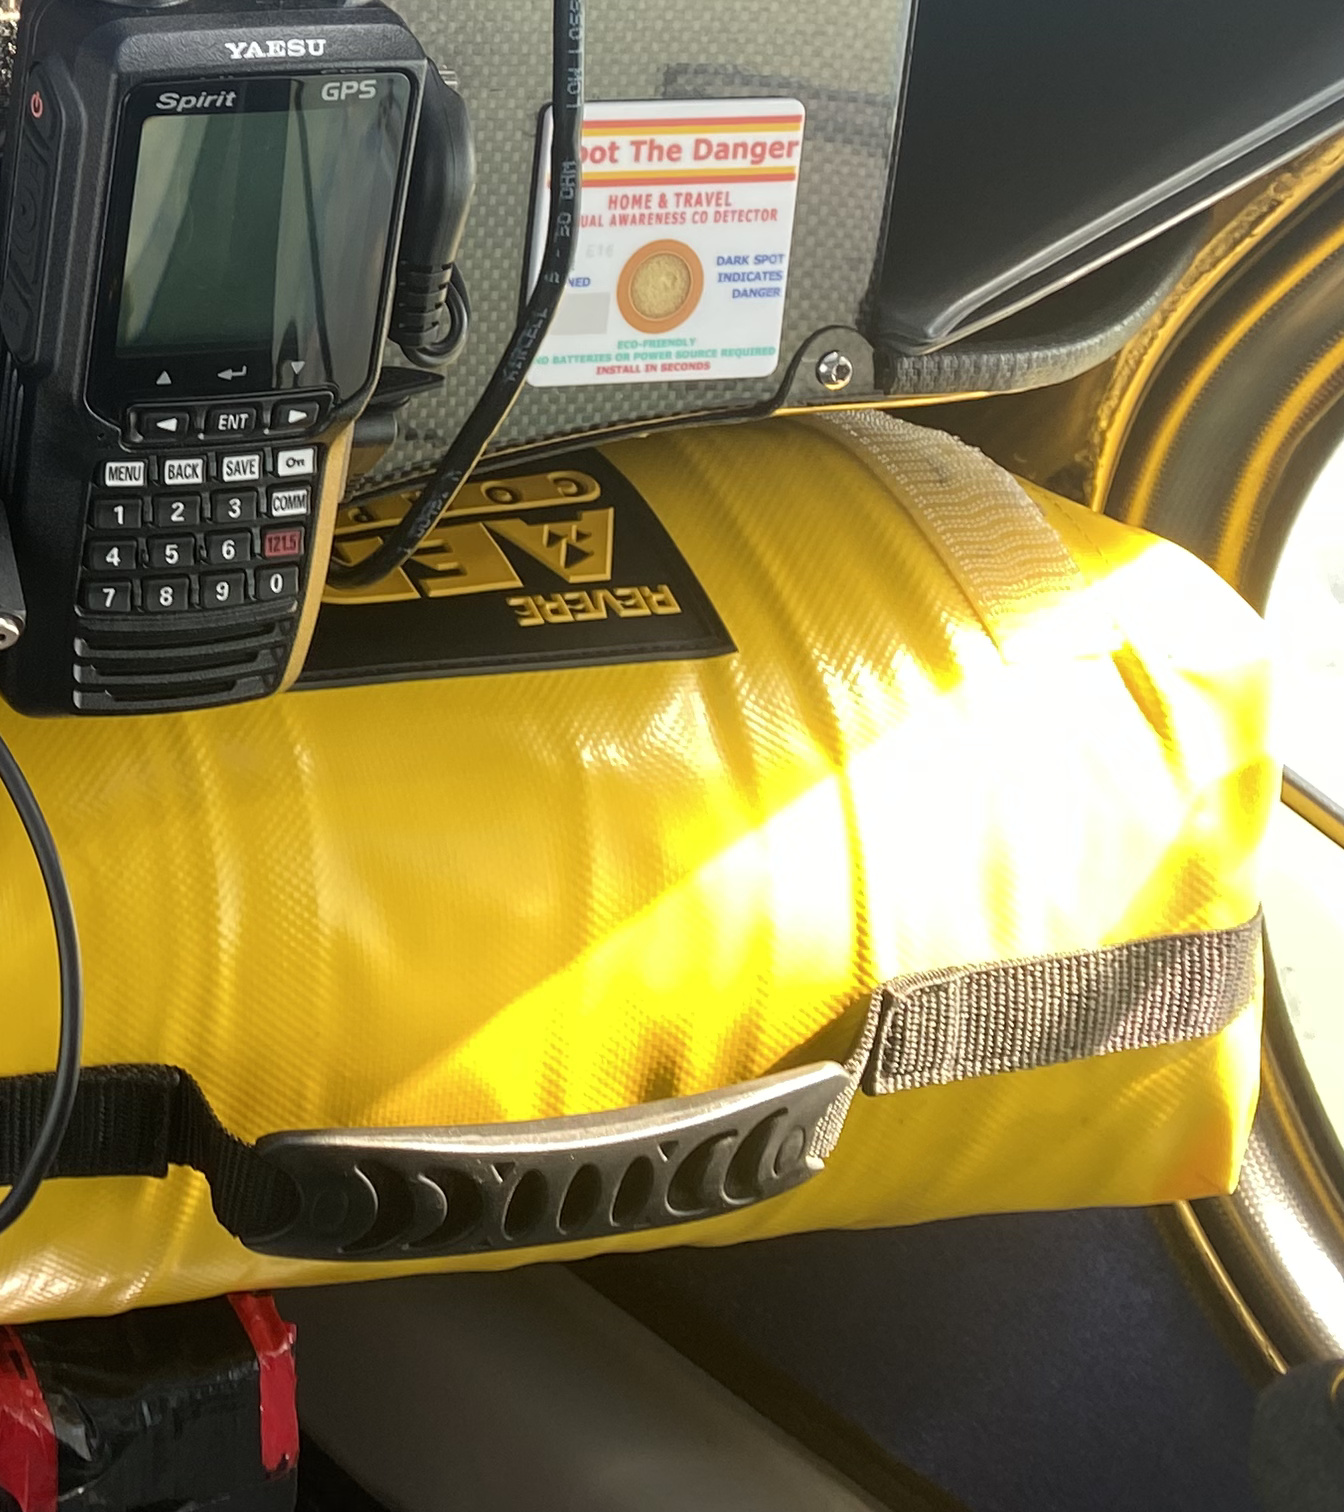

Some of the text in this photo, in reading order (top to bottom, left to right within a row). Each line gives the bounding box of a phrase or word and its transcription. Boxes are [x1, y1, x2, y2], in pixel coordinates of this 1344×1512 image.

[225, 39, 326, 59] YAESU
[321, 80, 377, 101] GPS
[156, 90, 236, 111] Spirit
[630, 139, 799, 165] The Danger
[608, 191, 732, 210] HOME & TRAVEL
[610, 209, 778, 226] AWARENESS CO DETECTOR
[717, 254, 784, 266] DARK SPOT
[718, 271, 782, 282] INDICATES
[732, 288, 780, 299] DANGER
[618, 338, 696, 349] ECO-FRIENDLY
[597, 362, 710, 375] INSTALL IN SECONDS
[218, 414, 248, 430] ENT
[109, 465, 141, 481] MENU
[168, 463, 199, 479] BACK
[226, 459, 255, 476] SAVE
[273, 493, 305, 511] COMM
[269, 534, 296, 552] 121.5
